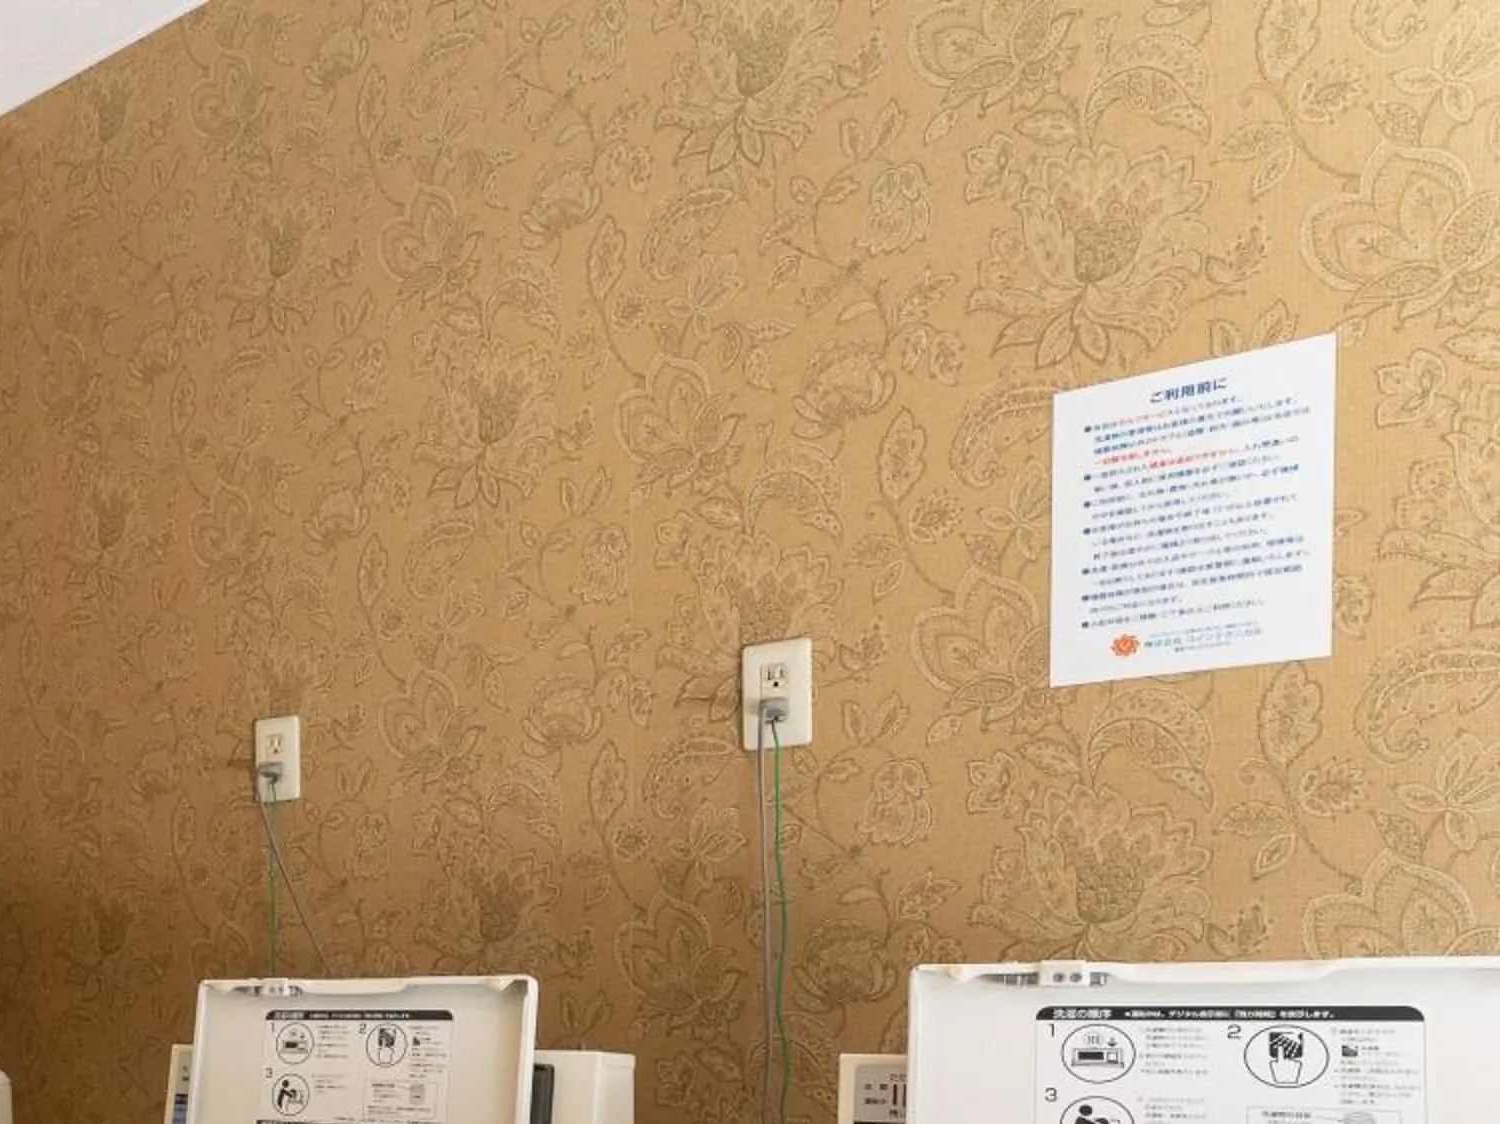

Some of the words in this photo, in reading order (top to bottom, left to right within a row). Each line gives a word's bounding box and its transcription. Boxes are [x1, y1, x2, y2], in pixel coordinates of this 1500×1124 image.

[1149, 377, 1228, 404] ご利用前に
[1048, 1023, 1056, 1038] 1
[1227, 1023, 1242, 1040] 2
[1044, 1087, 1058, 1103] 3
